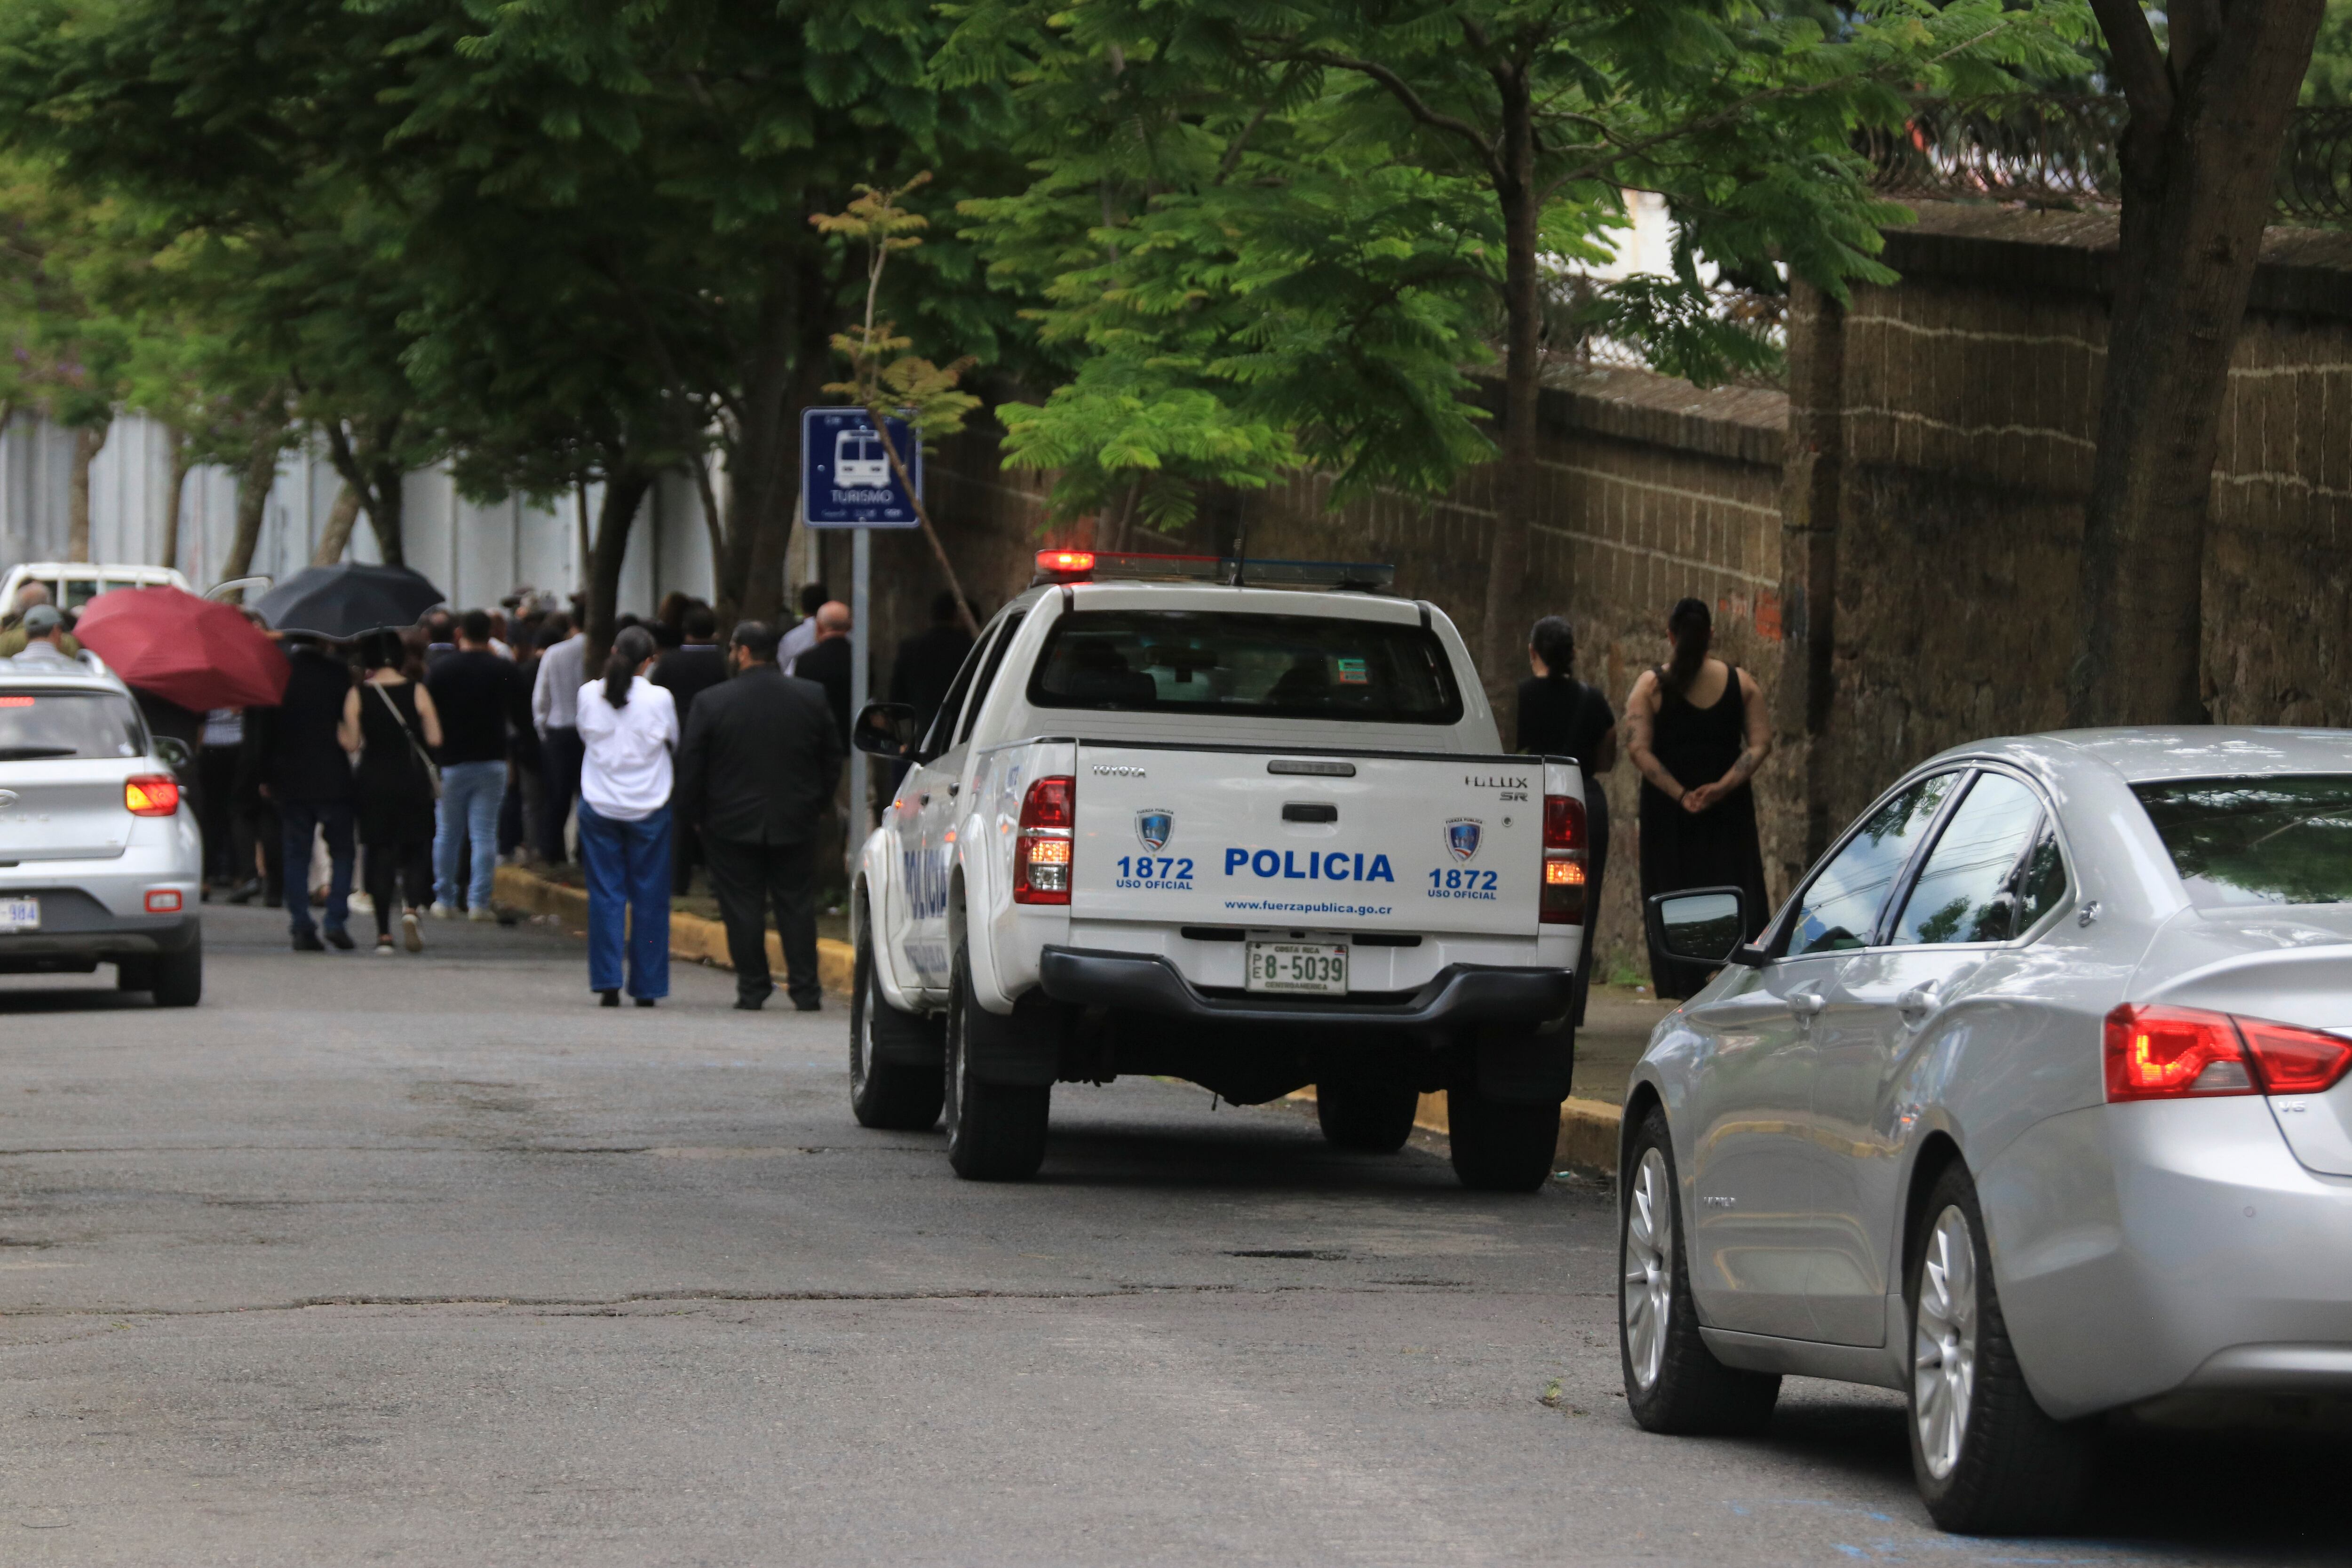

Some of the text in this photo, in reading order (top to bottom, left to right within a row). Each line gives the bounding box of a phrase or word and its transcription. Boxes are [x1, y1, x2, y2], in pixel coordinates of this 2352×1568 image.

[830, 489, 894, 504] TURISMO
[1092, 764, 1146, 777] TOYOTA
[1464, 776, 1528, 788] HILUX
[1500, 791, 1528, 801] SR
[1117, 856, 1193, 879] 1872
[1225, 848, 1395, 882] POLICIA
[1116, 879, 1192, 890] USO OFICIAL
[1429, 868, 1497, 890] 1872
[1428, 889, 1496, 900] USO OFICIAL
[1225, 900, 1392, 915] www.fuerzapublica.go.cr
[1265, 955, 1343, 982] 8-5039
[1265, 981, 1327, 990] CENTROAMERICA
